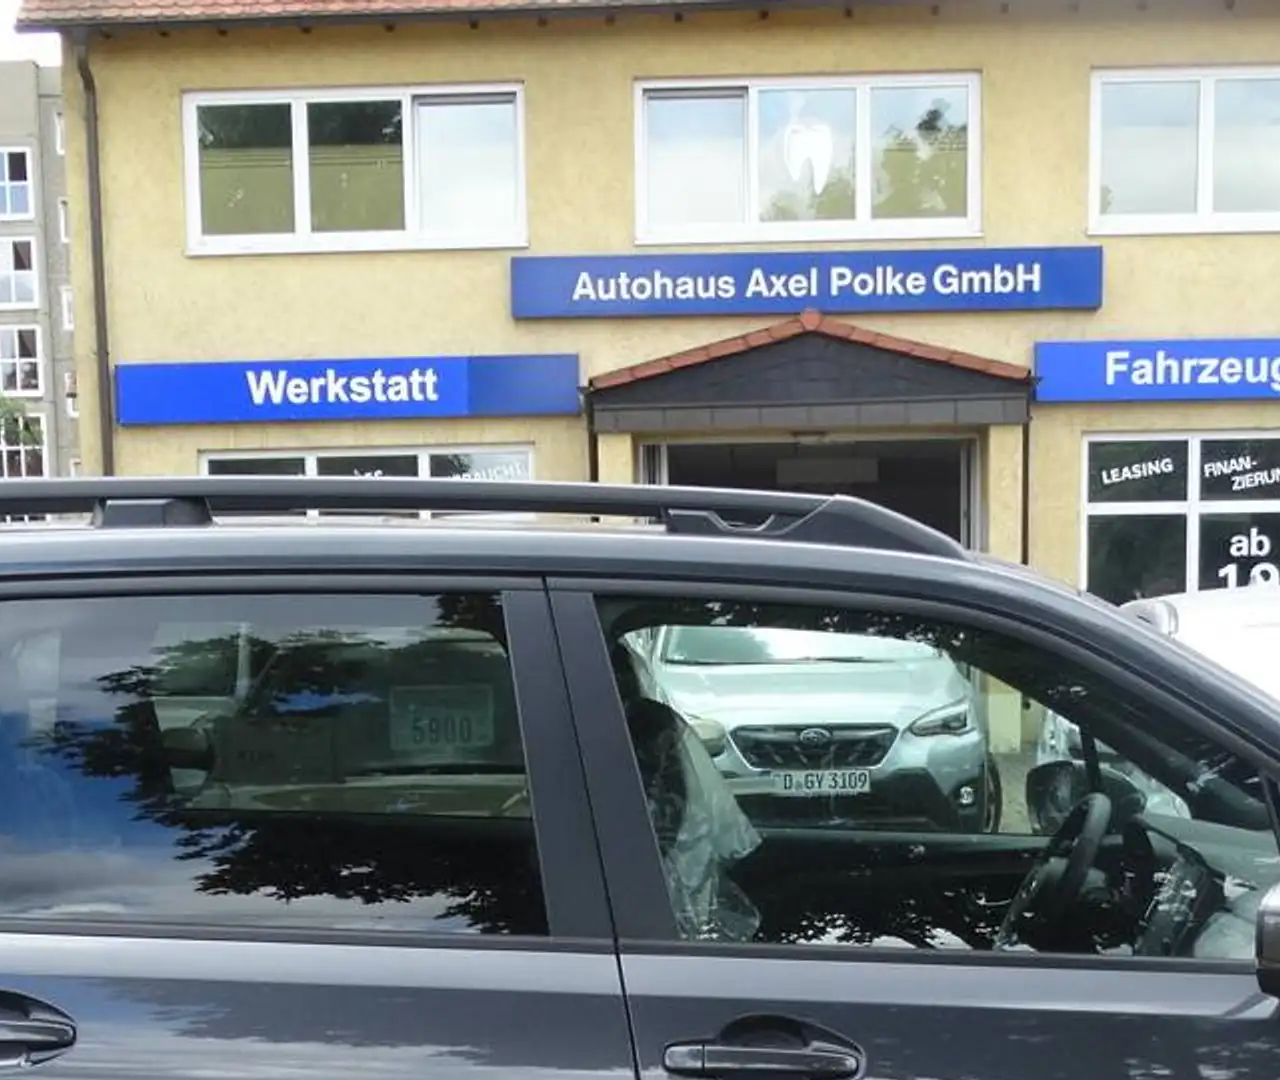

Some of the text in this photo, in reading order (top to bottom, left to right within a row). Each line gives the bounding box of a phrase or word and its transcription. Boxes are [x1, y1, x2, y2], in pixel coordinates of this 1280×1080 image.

[572, 263, 1042, 302] Autohaus Axel Polke GmbH
[246, 368, 438, 405] Werkstatt
[1102, 458, 1173, 484] LEASING
[1203, 455, 1258, 478] FINAN-
[1229, 528, 1270, 558] ab
